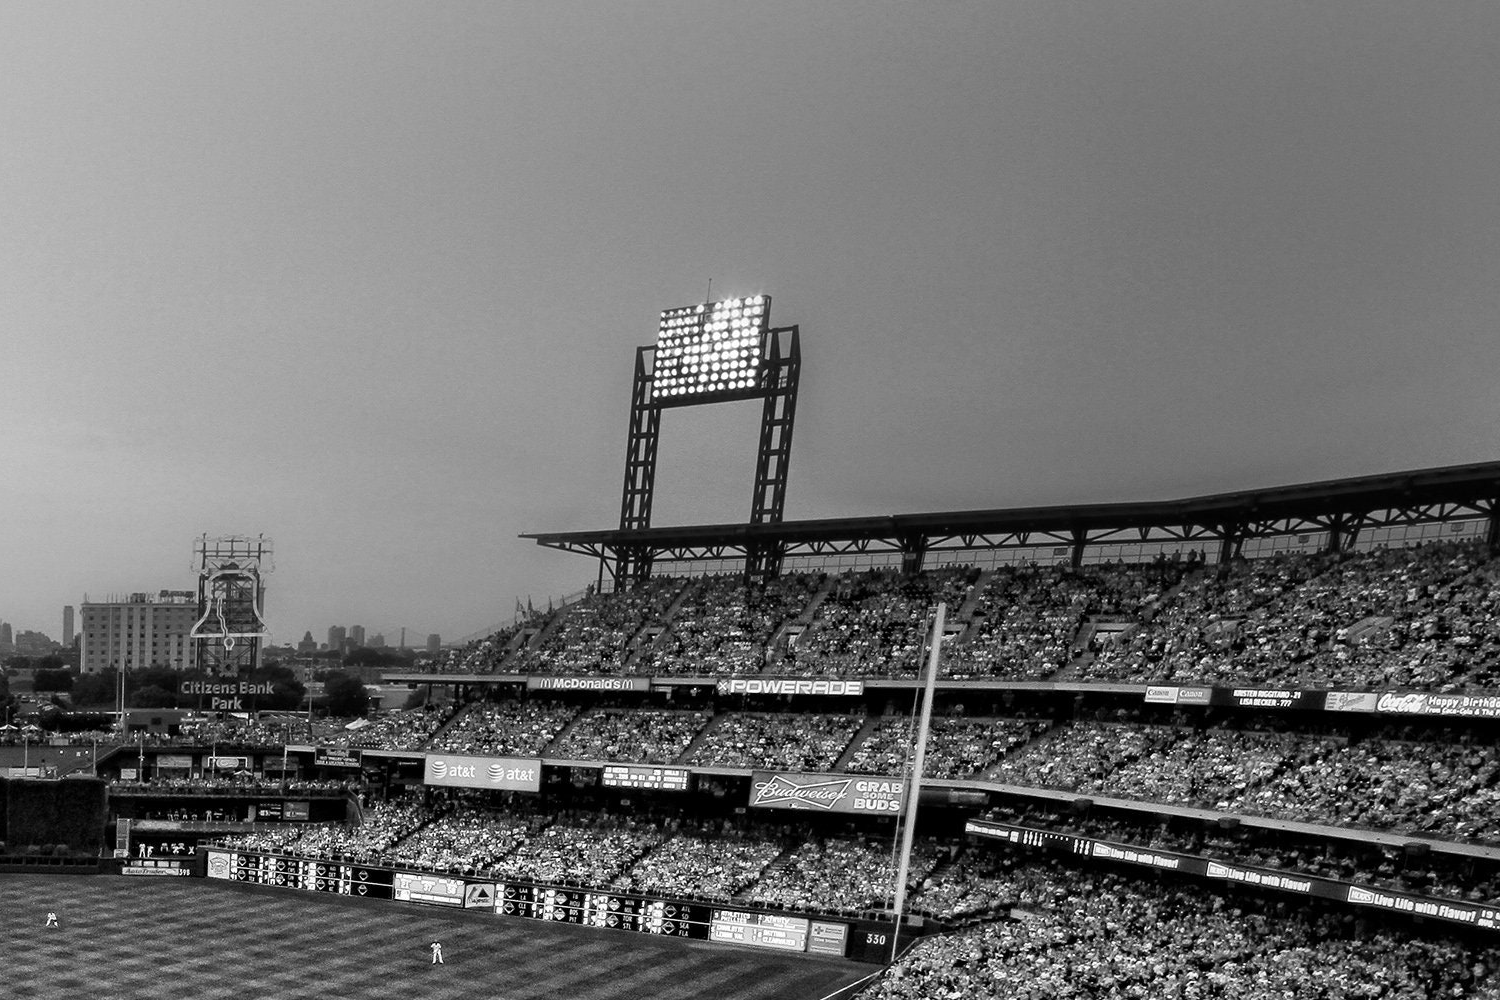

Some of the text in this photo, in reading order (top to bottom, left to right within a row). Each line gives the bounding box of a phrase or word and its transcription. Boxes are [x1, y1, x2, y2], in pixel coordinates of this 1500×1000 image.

[181, 681, 274, 694] Citizens Bank
[553, 679, 622, 690] McDonald's
[731, 680, 862, 695] POWERADE
[1180, 689, 1203, 697] Canon
[211, 696, 243, 710] Park
[1377, 693, 1428, 713] Coca-Cola
[1429, 696, 1459, 708] Happy
[1442, 708, 1473, 716] Coca-Cola
[449, 765, 475, 778] at&t
[506, 767, 535, 782] at&t
[755, 781, 848, 800] Budweiser
[855, 781, 903, 794] GRAB
[862, 792, 894, 800] SOME
[853, 798, 900, 811] BUDS
[1228, 868, 1311, 893] Live Life with Flavor!
[1374, 894, 1477, 923] Live Life with Flavor!
[721, 911, 751, 920] ATHLETICS
[764, 915, 791, 925] xfinity
[866, 933, 886, 945] 330
